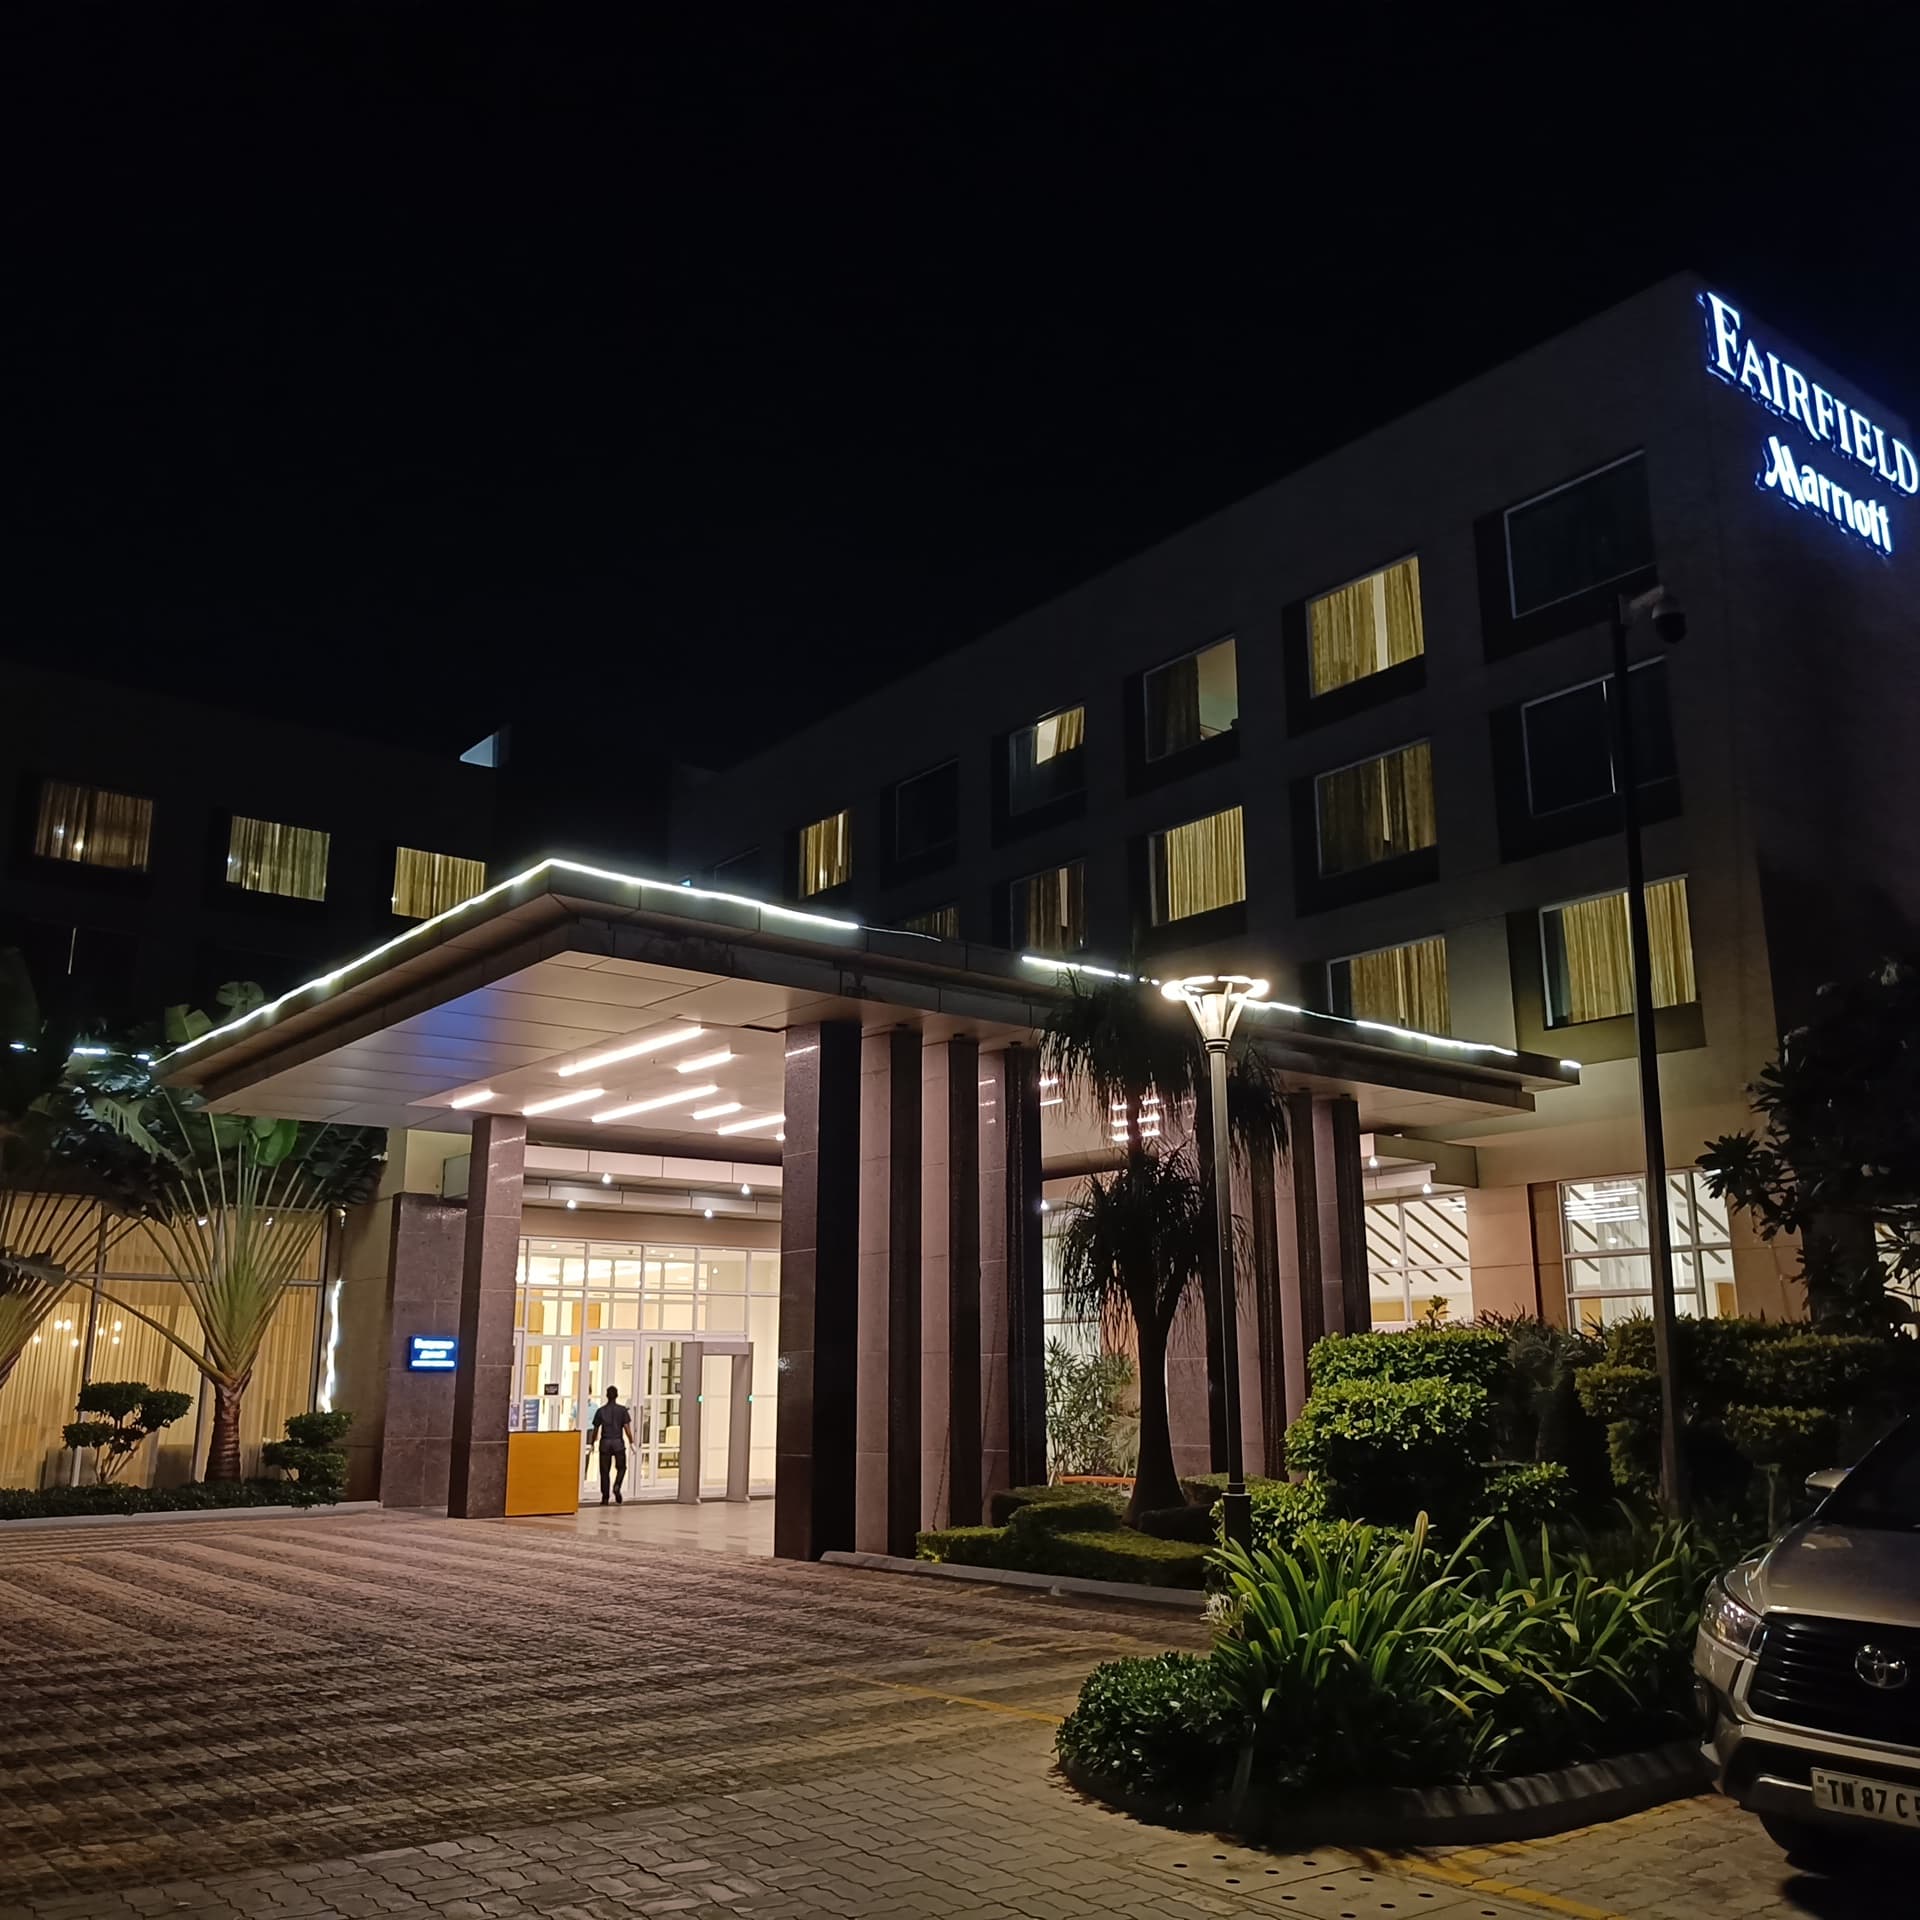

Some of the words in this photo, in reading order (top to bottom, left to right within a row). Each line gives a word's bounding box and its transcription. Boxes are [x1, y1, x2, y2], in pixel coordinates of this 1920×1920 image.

[1706, 291, 1919, 495] FAIRFIELD
[1764, 435, 1892, 553] Marriott
[1827, 1779, 1854, 1808] TN
[1862, 1786, 1887, 1814] 87
